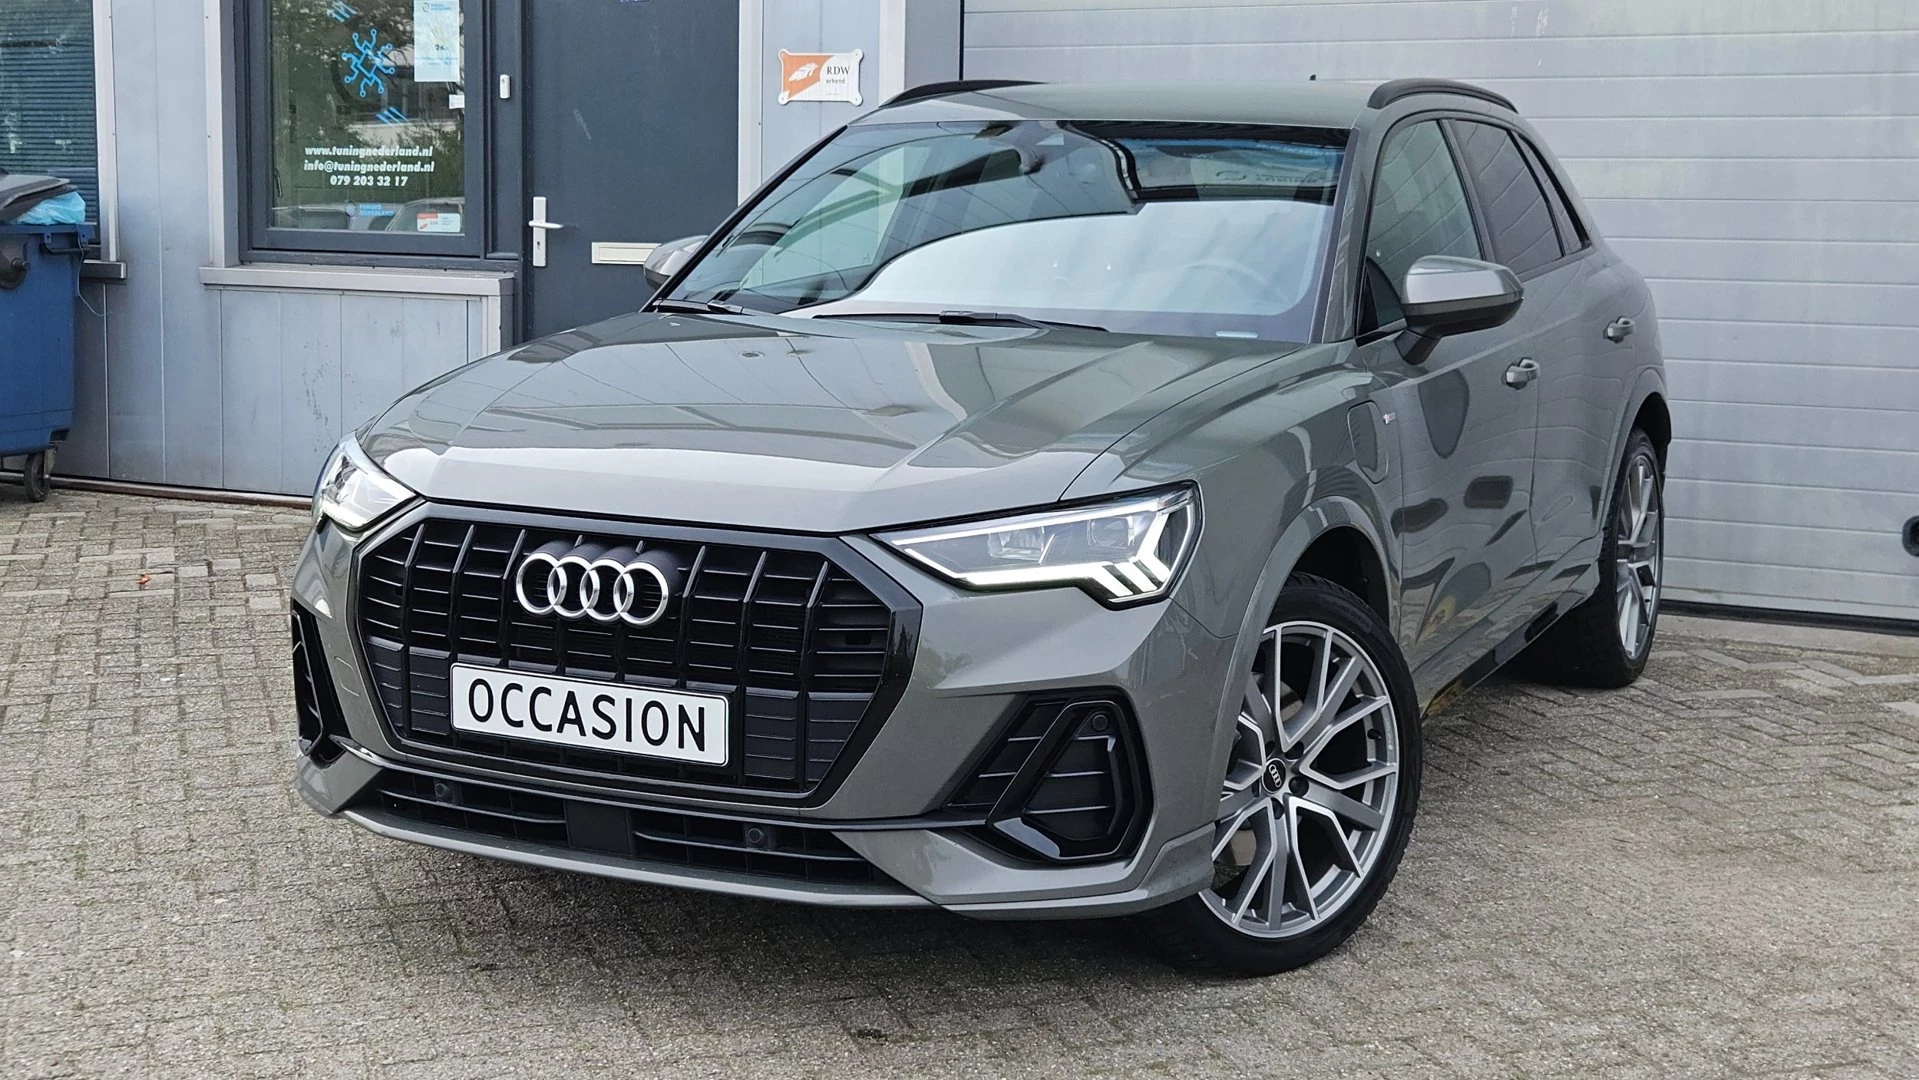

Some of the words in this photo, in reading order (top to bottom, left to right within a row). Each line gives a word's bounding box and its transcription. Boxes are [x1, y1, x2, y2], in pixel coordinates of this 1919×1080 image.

[826, 66, 850, 75] RDW
[305, 145, 433, 158] www.tuningnederland.nl
[304, 160, 435, 174] info@tuningnederland.nl
[330, 175, 351, 186] 079
[353, 175, 374, 186] 203
[376, 176, 391, 187] 32
[394, 176, 408, 187] 17
[468, 678, 705, 752] OCCASION
